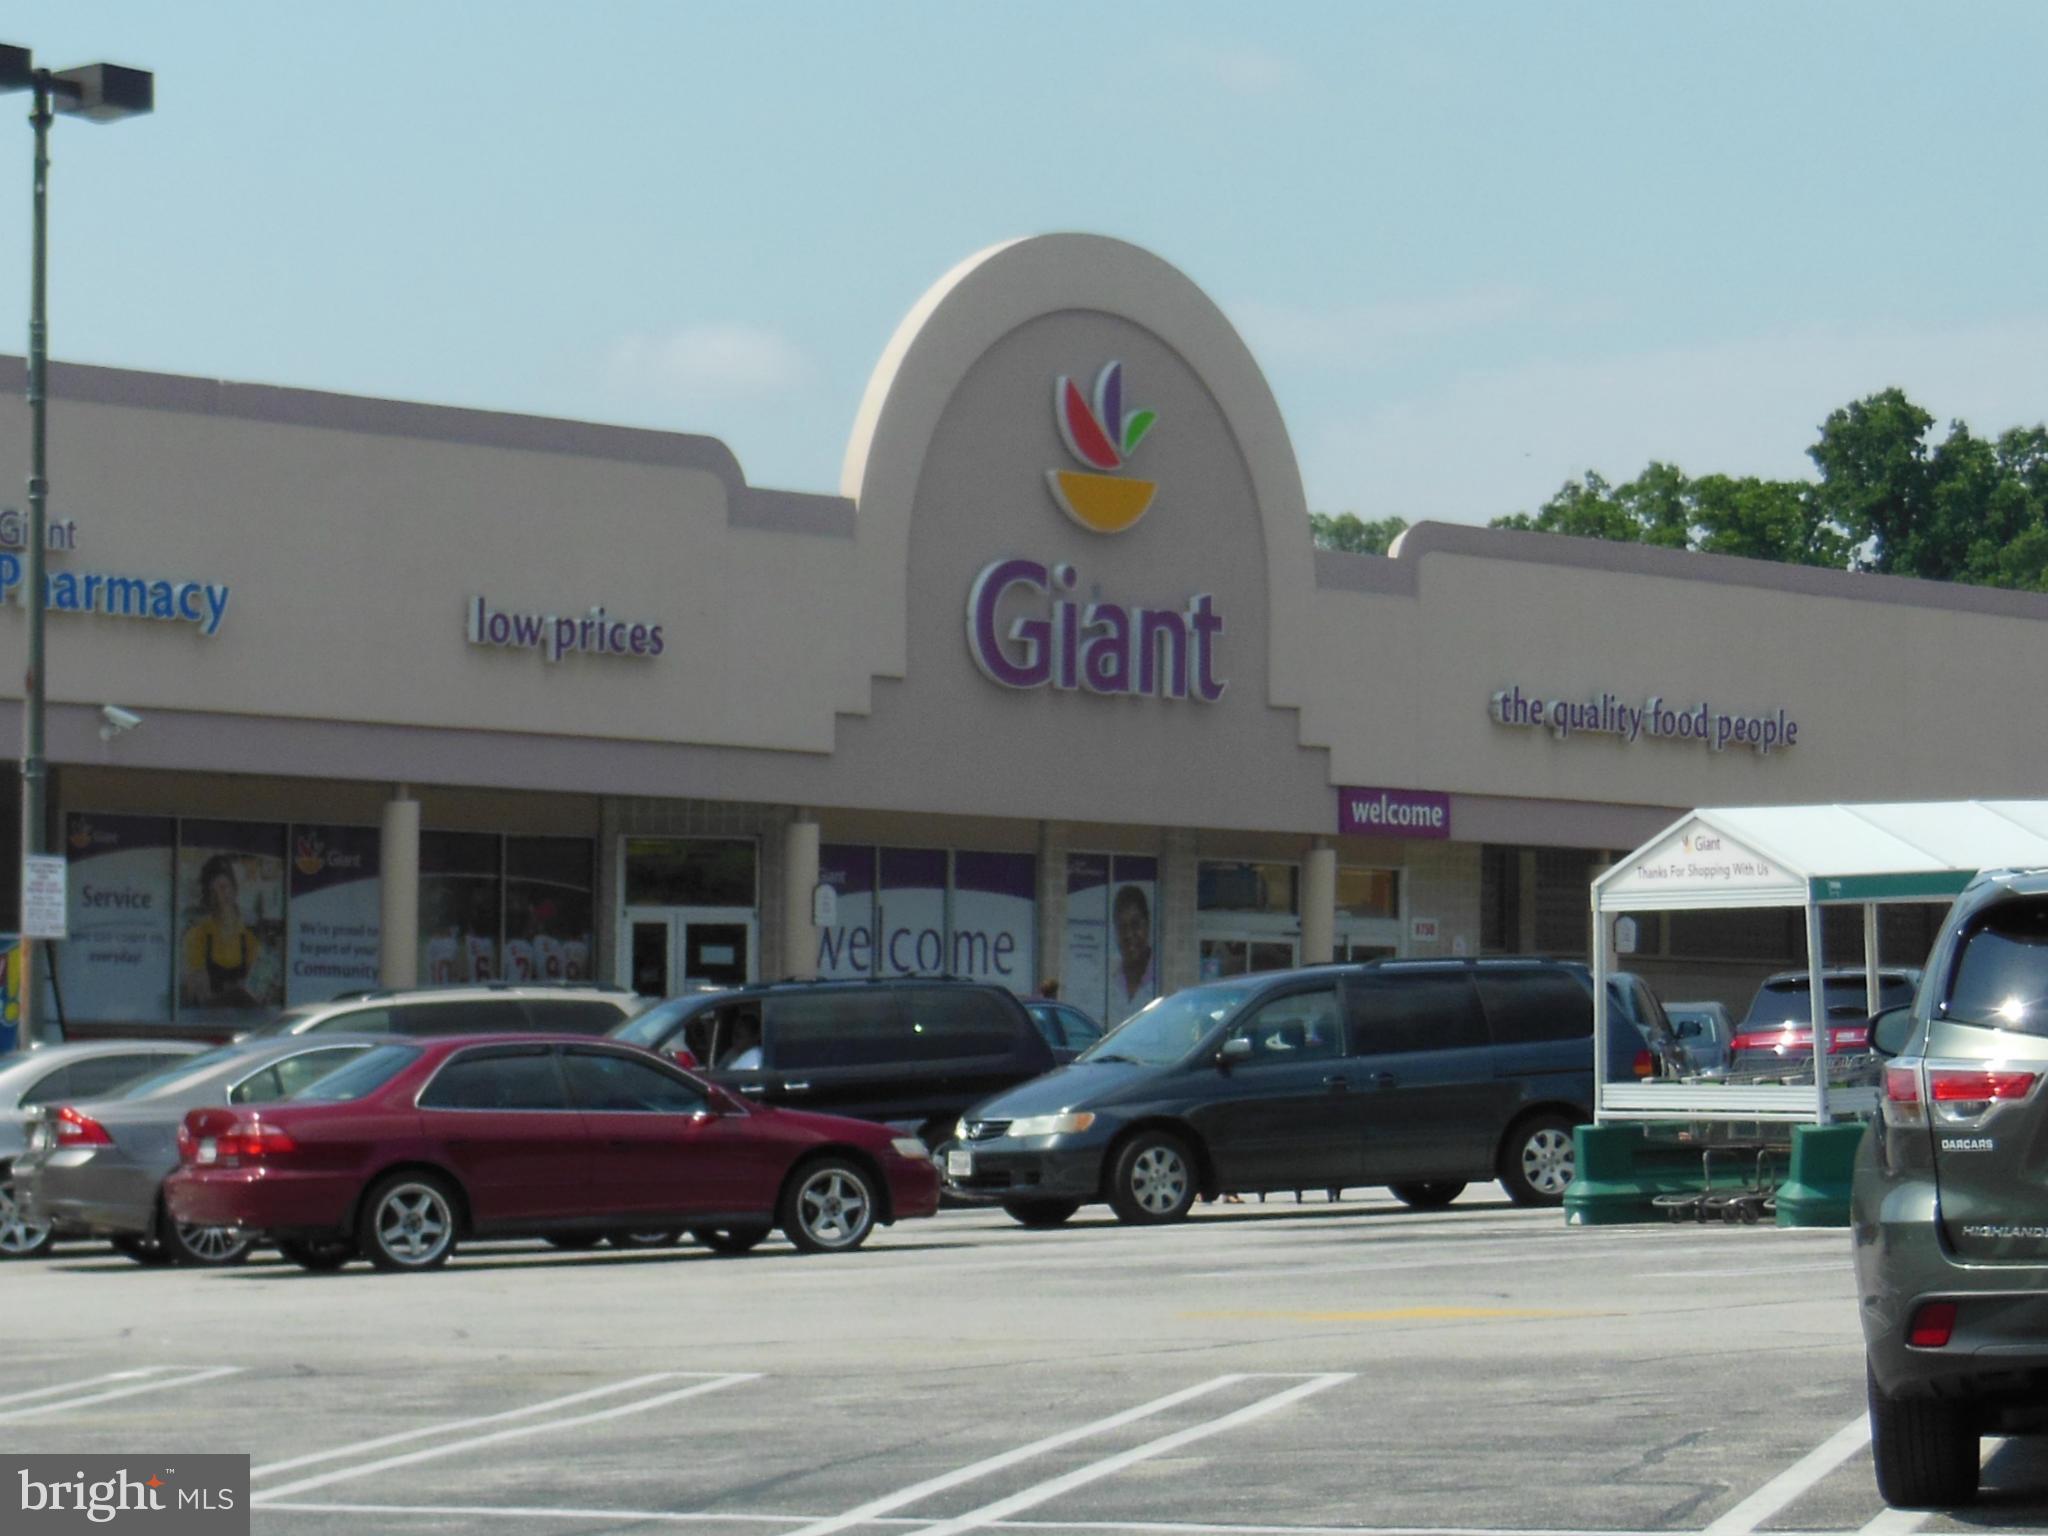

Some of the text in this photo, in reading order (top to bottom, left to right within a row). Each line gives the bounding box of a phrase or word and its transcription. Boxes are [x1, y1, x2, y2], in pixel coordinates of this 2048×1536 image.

[0, 511, 77, 549] Gint
[469, 595, 664, 662] low prices
[966, 559, 1229, 702] Giant
[1490, 686, 1799, 753] the quality food people
[1351, 794, 1443, 827] welcome
[1694, 835, 1721, 852] Giant
[1637, 861, 1769, 880] Thanks For Shopping With Us
[81, 884, 153, 910] Service
[1941, 1139, 1994, 1150] DARCARS
